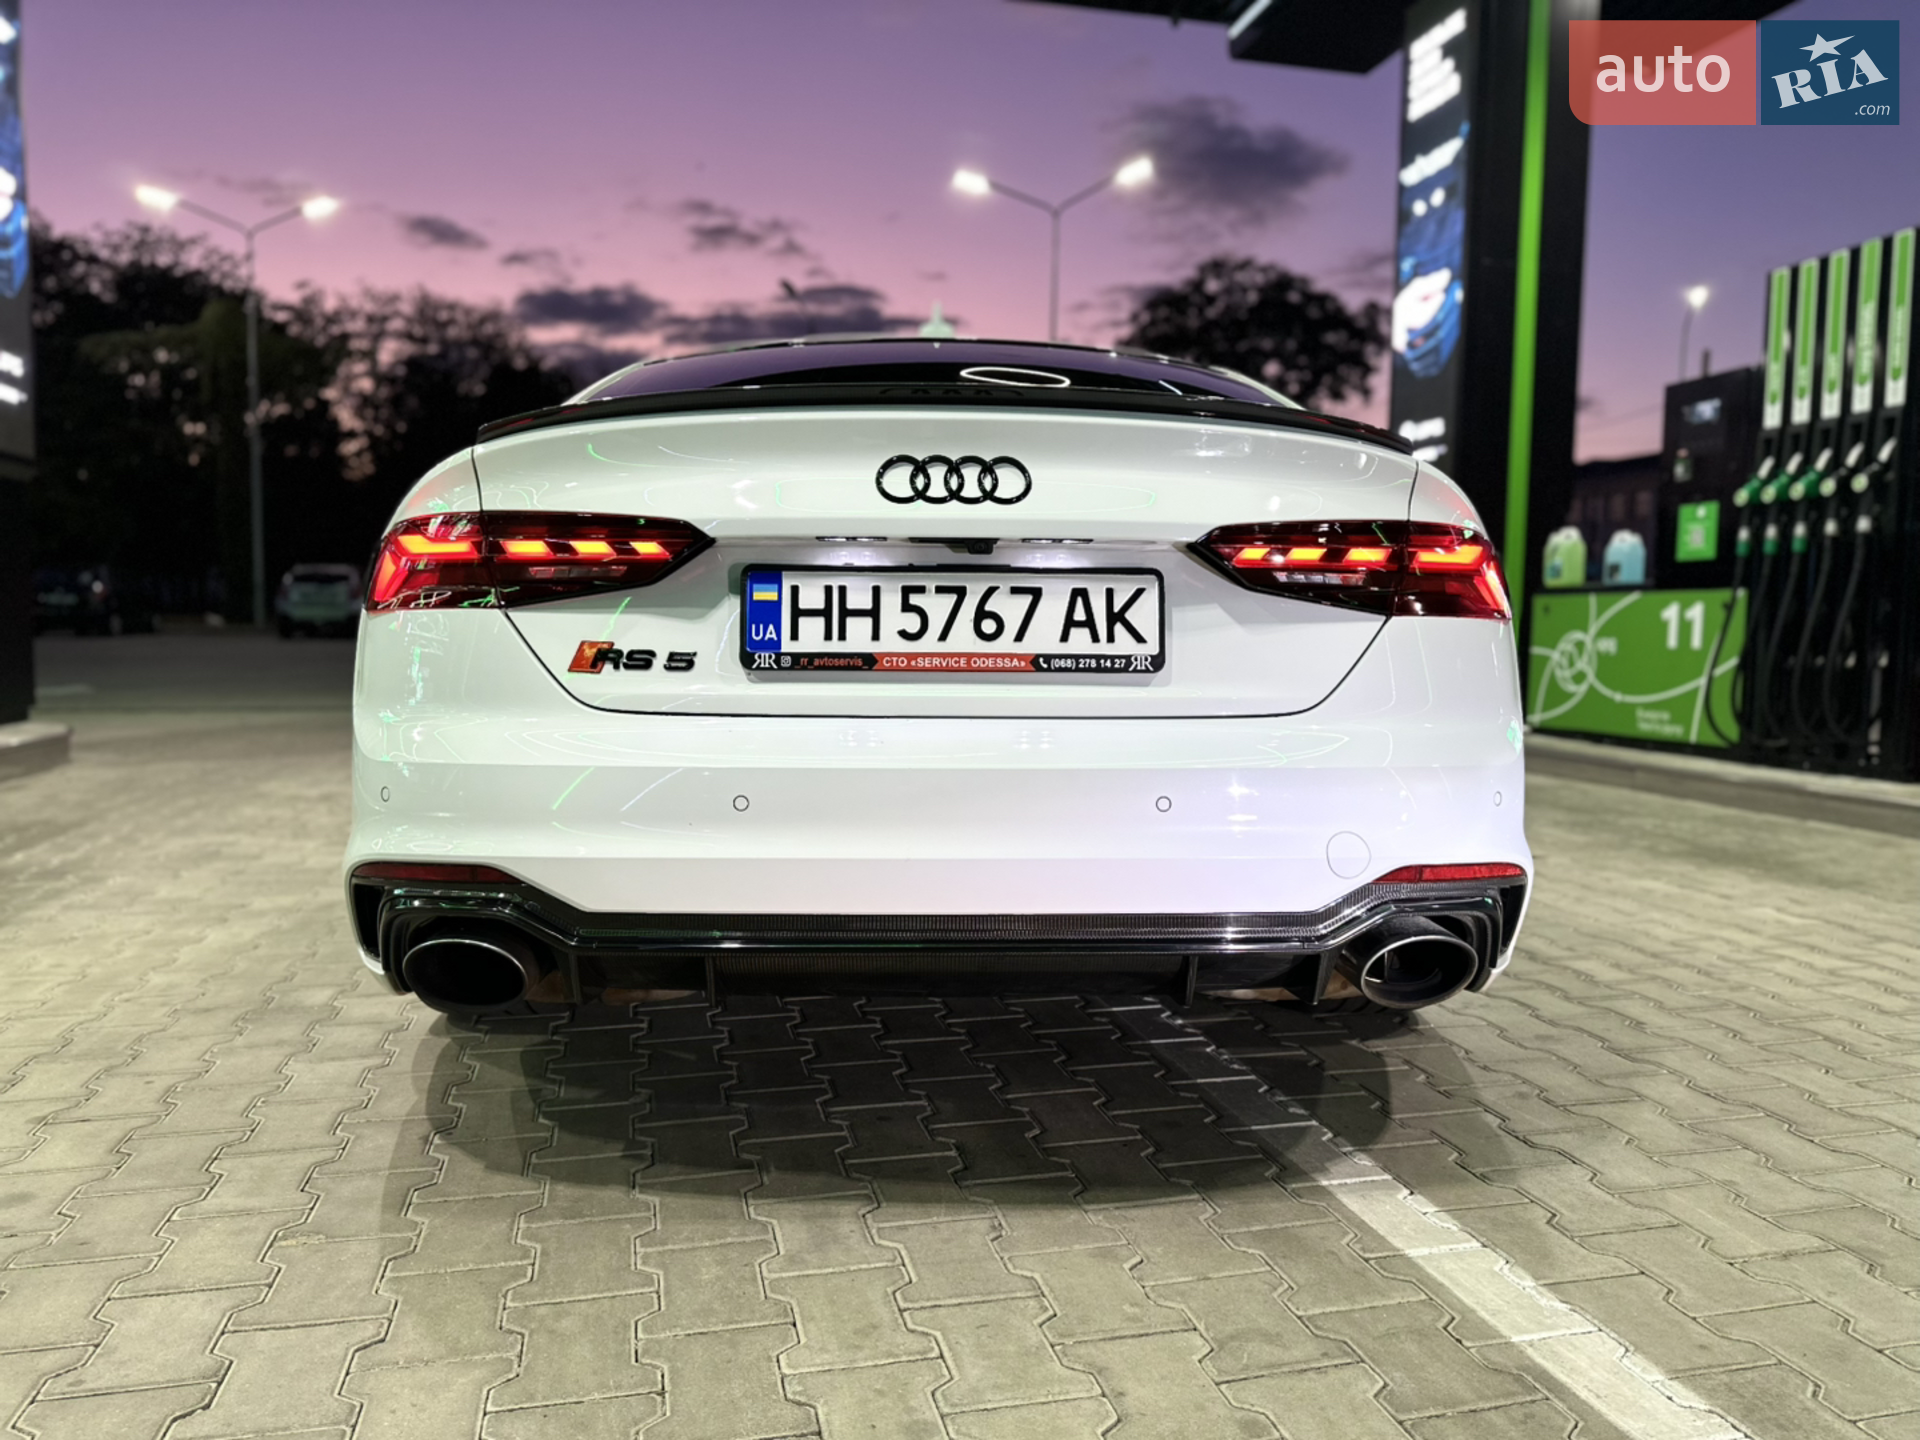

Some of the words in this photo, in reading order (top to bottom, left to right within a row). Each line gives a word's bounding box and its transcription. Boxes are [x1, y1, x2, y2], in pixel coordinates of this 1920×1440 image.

[789, 584, 881, 642] HH
[896, 585, 1043, 643] 5767
[1059, 586, 1148, 644] AK
[751, 624, 778, 641] UA
[1660, 600, 1705, 650] 11
[663, 651, 698, 672] 5
[1050, 658, 1077, 670] (068)
[1078, 659, 1097, 669] 278
[1100, 659, 1112, 669] 14
[1114, 659, 1126, 669] 27
